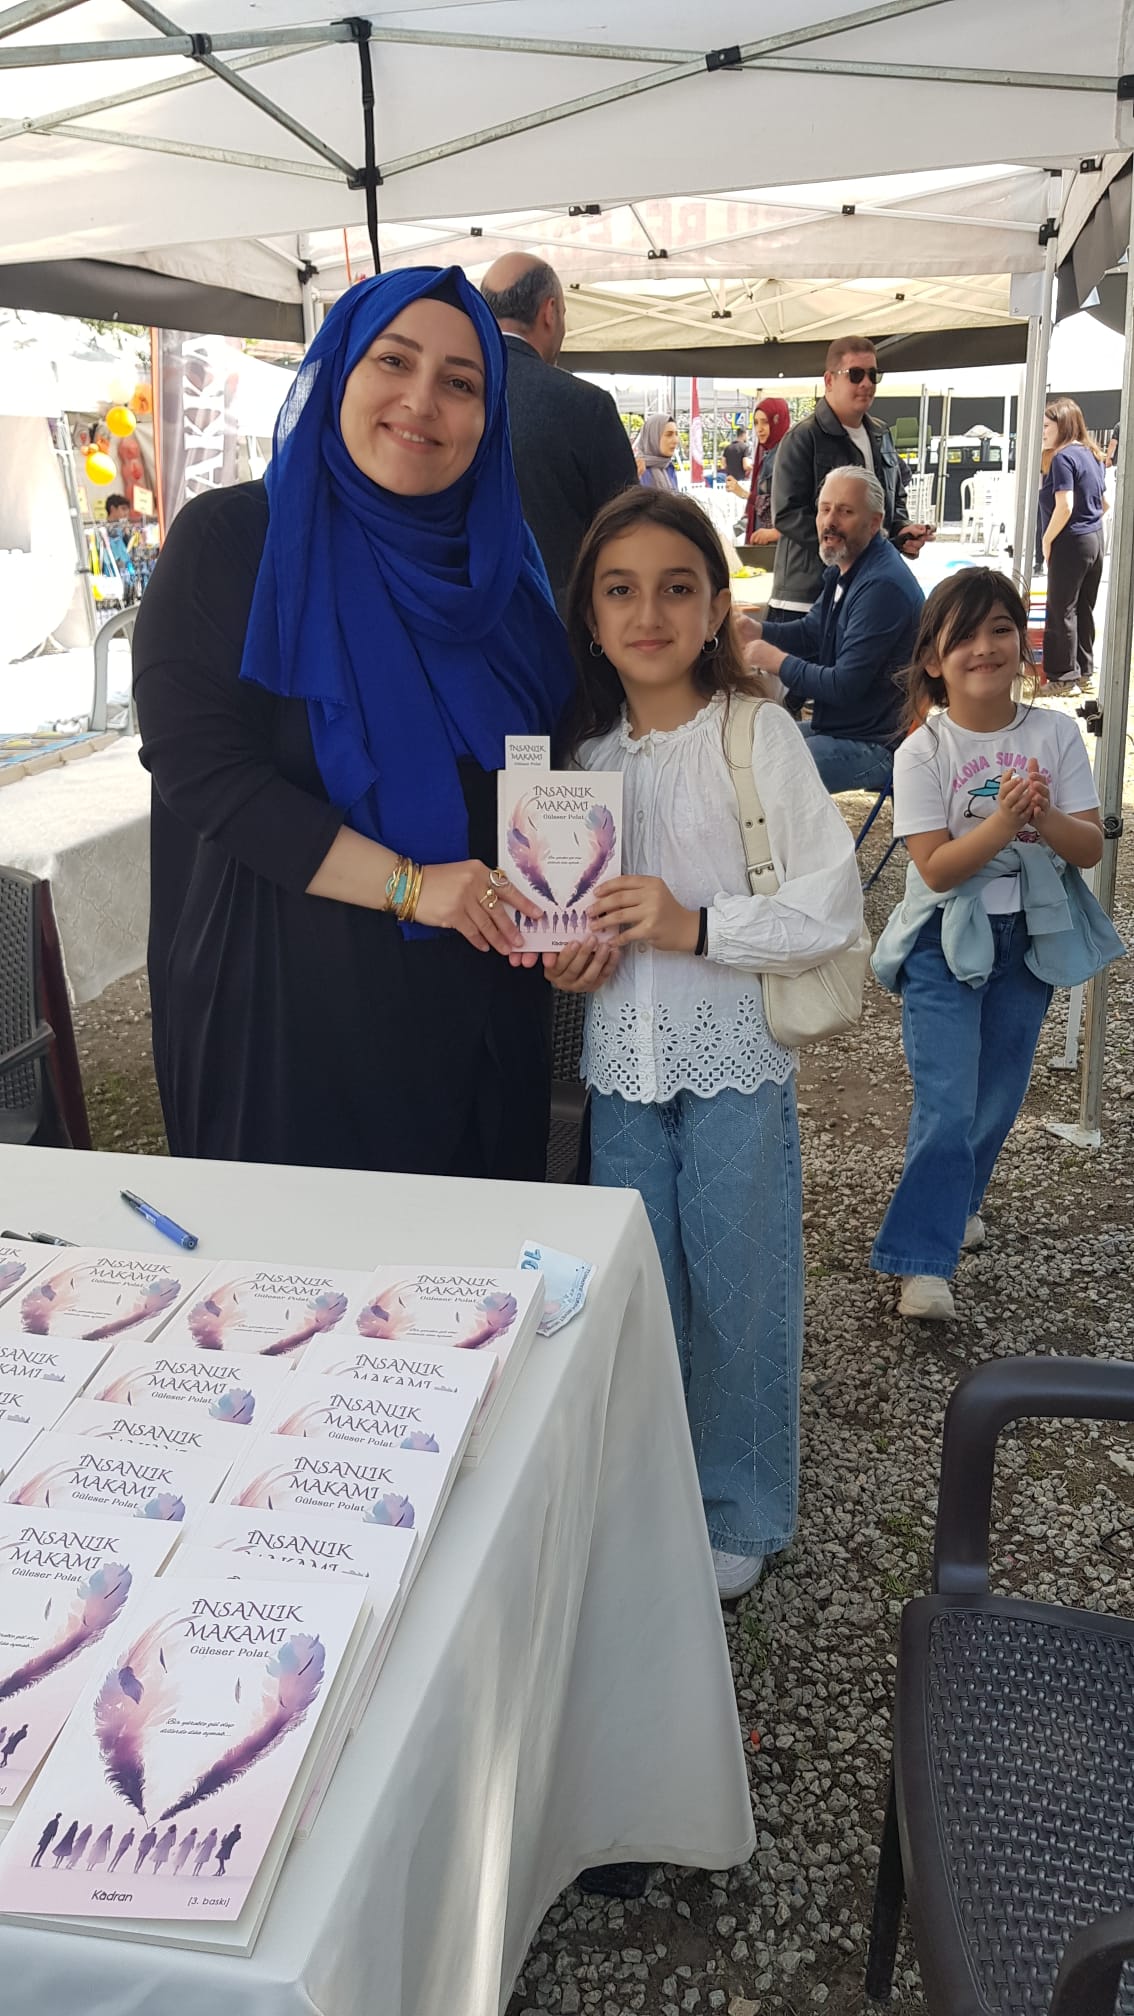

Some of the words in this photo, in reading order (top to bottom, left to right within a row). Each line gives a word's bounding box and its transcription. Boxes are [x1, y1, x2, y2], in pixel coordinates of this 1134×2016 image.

[952, 755, 990, 793] ALOHA
[536, 800, 589, 812] MAKAMI
[89, 1268, 159, 1282] MAKAMI
[250, 1283, 322, 1296] MAKAMI
[415, 1285, 487, 1297] MAKAMI
[0, 1347, 60, 1366] SANLIK
[0, 1363, 43, 1378] KAMI
[147, 1374, 228, 1394] MAKAMI
[187, 1395, 212, 1404] Polat
[323, 1411, 408, 1438] MAKAMI
[367, 1437, 393, 1447] Polat
[68, 1471, 158, 1499] MAKAMI
[289, 1475, 379, 1501] MAKAMI
[111, 1498, 138, 1509] Polat
[337, 1500, 365, 1512] Polat
[9, 1546, 103, 1571] MAKAMI
[53, 1572, 82, 1582] Polat
[183, 1621, 288, 1645] MAKAMI
[190, 1645, 235, 1657] Güleser
[237, 1647, 270, 1658] Polat
